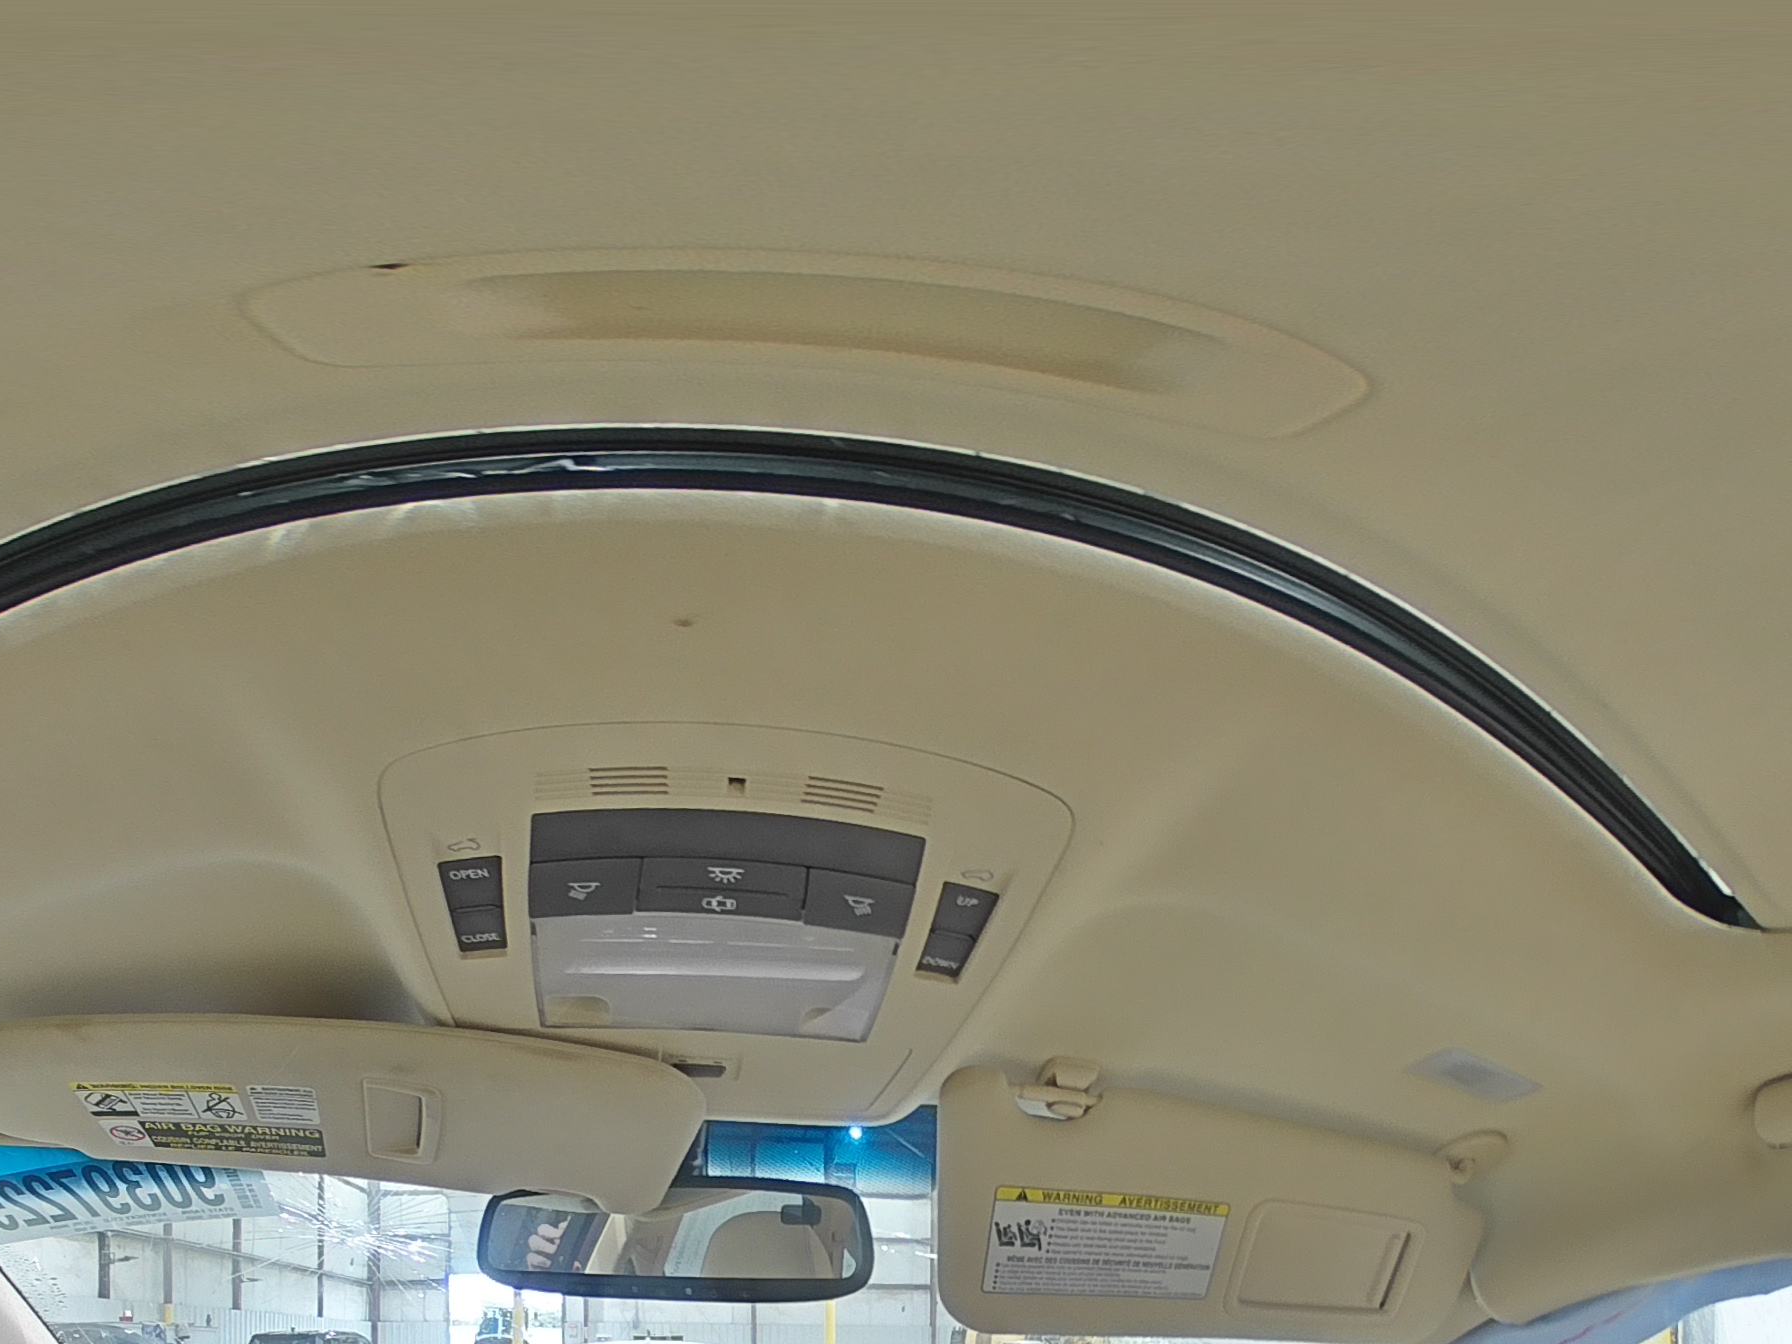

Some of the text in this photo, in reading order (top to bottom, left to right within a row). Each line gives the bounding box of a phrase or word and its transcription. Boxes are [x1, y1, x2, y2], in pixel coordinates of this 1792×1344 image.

[449, 868, 490, 880] OPEN
[956, 894, 979, 907] UP
[460, 932, 501, 944] CLOSE
[144, 1122, 321, 1139] AIR BAG WARNING
[1042, 1191, 1219, 1214] WARNING AVERTISSEMENT
[1058, 1208, 1082, 1217] EVEN
